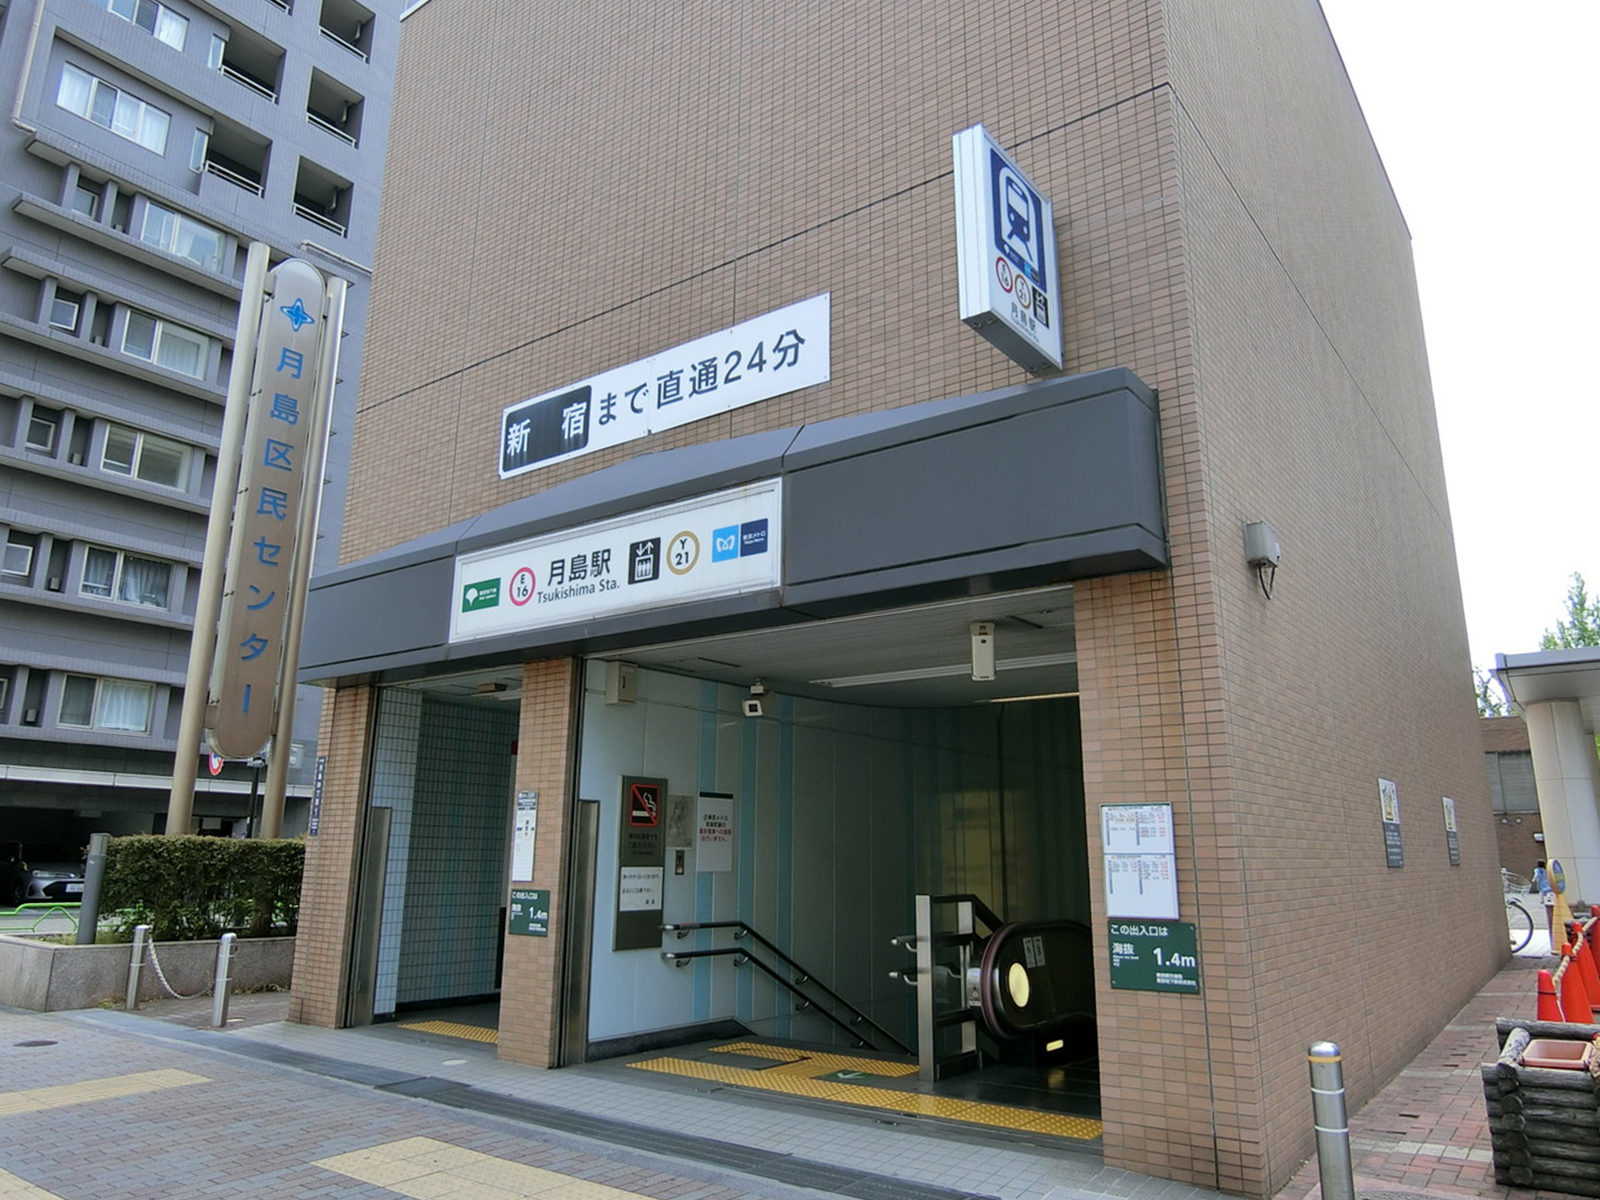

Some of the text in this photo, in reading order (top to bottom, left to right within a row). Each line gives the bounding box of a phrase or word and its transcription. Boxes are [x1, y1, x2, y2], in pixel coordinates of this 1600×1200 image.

[240, 346, 304, 713] 月島区民センター
[679, 538, 688, 550] Y
[675, 552, 690, 566] 21
[547, 548, 612, 587] 月島駅
[520, 574, 526, 584] E
[517, 585, 529, 597] 16
[537, 577, 620, 604] Tsukishima Sta.
[1111, 925, 1169, 937] この出入口は
[1112, 942, 1135, 955] 海抜
[1153, 947, 1196, 968] 1.4m
